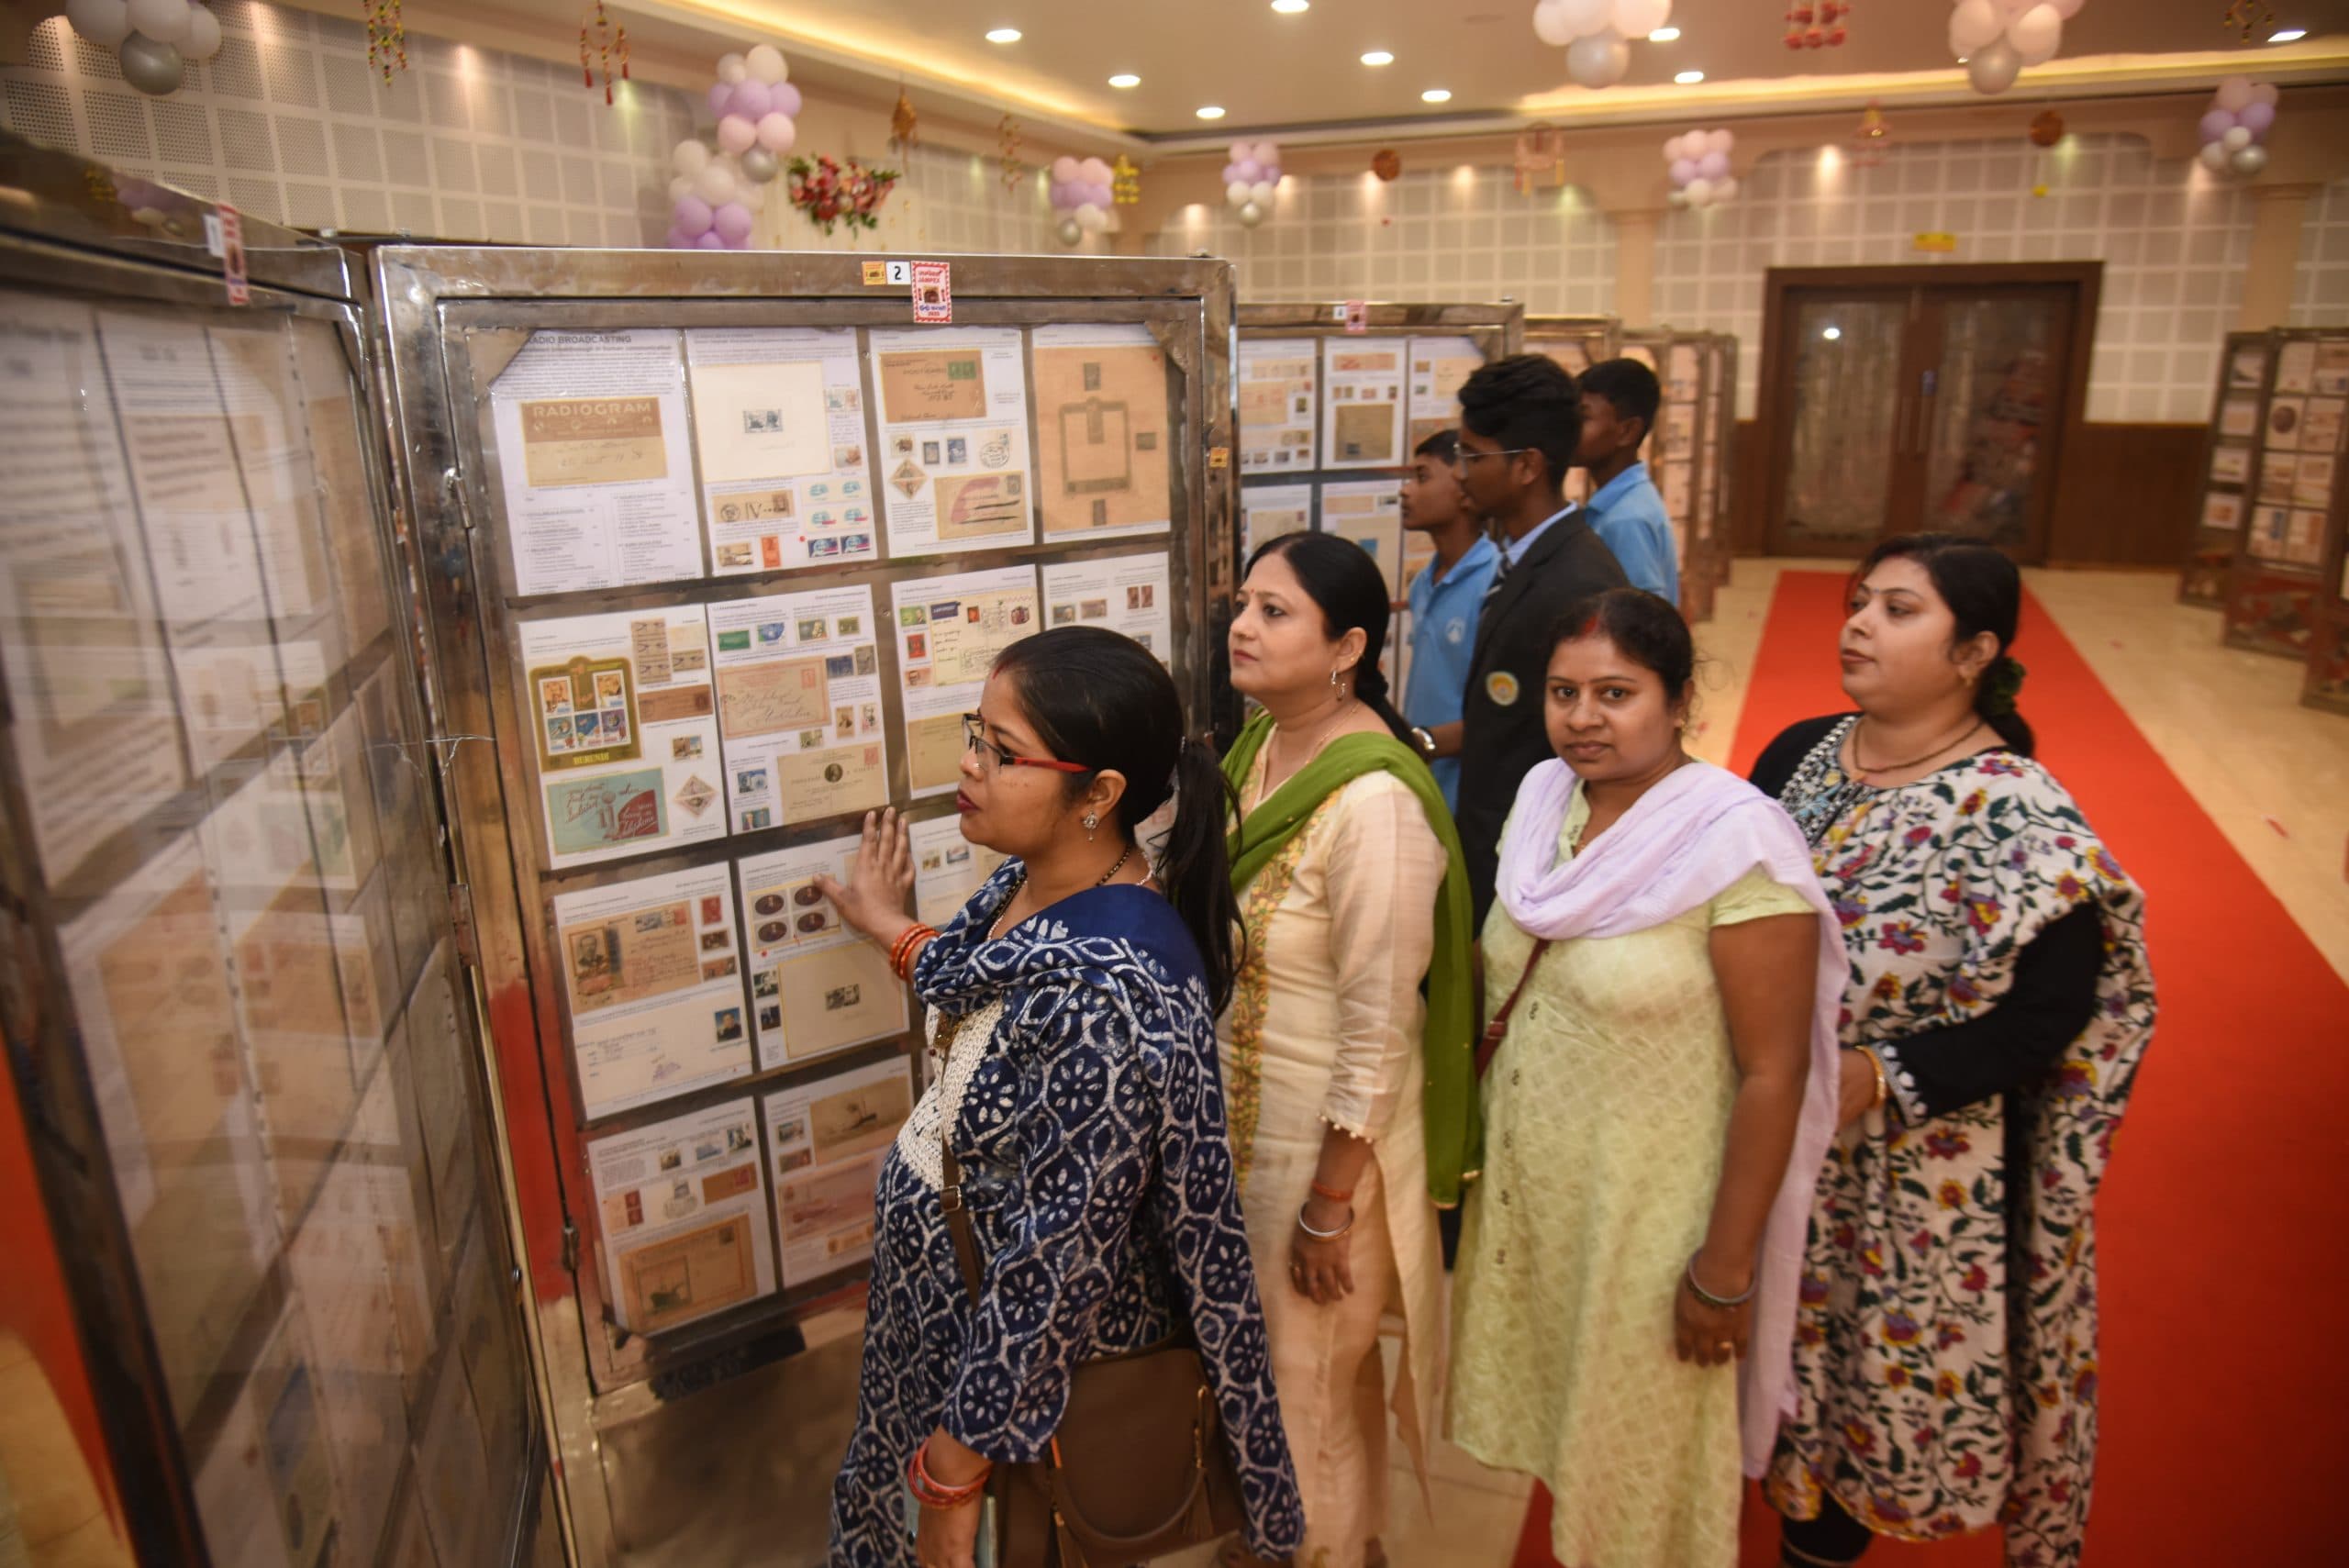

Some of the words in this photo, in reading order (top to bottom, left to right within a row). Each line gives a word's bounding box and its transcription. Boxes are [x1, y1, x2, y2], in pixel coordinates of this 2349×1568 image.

[894, 266, 902, 280] 2
[558, 335, 632, 344] BROADCASTING
[532, 402, 651, 417] RADIOGRAM
